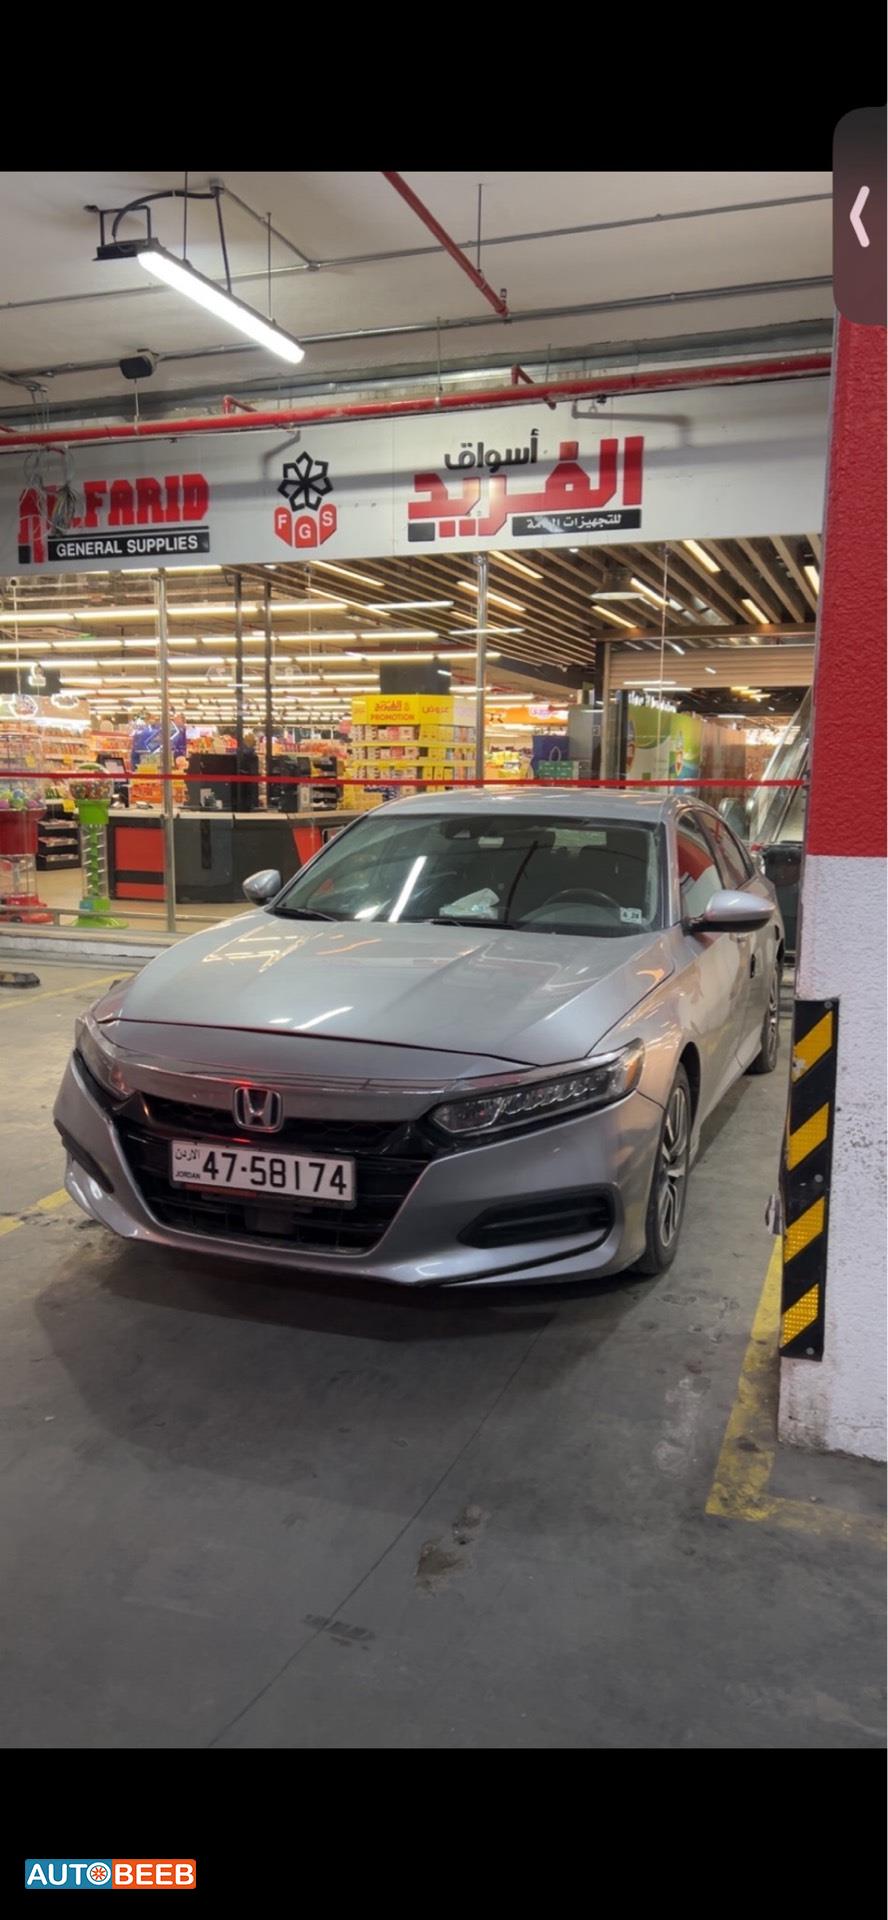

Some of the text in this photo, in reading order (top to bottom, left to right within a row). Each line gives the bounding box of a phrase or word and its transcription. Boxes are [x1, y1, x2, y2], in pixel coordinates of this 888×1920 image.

[444, 428, 540, 473] أسواق
[407, 436, 644, 537] الفريد
[564, 513, 622, 529] للتجهيزات
[57, 535, 198, 558] GENERAL SUPPLIES
[370, 713, 415, 721] PROMOTION
[176, 1171, 201, 1180] JORDAN
